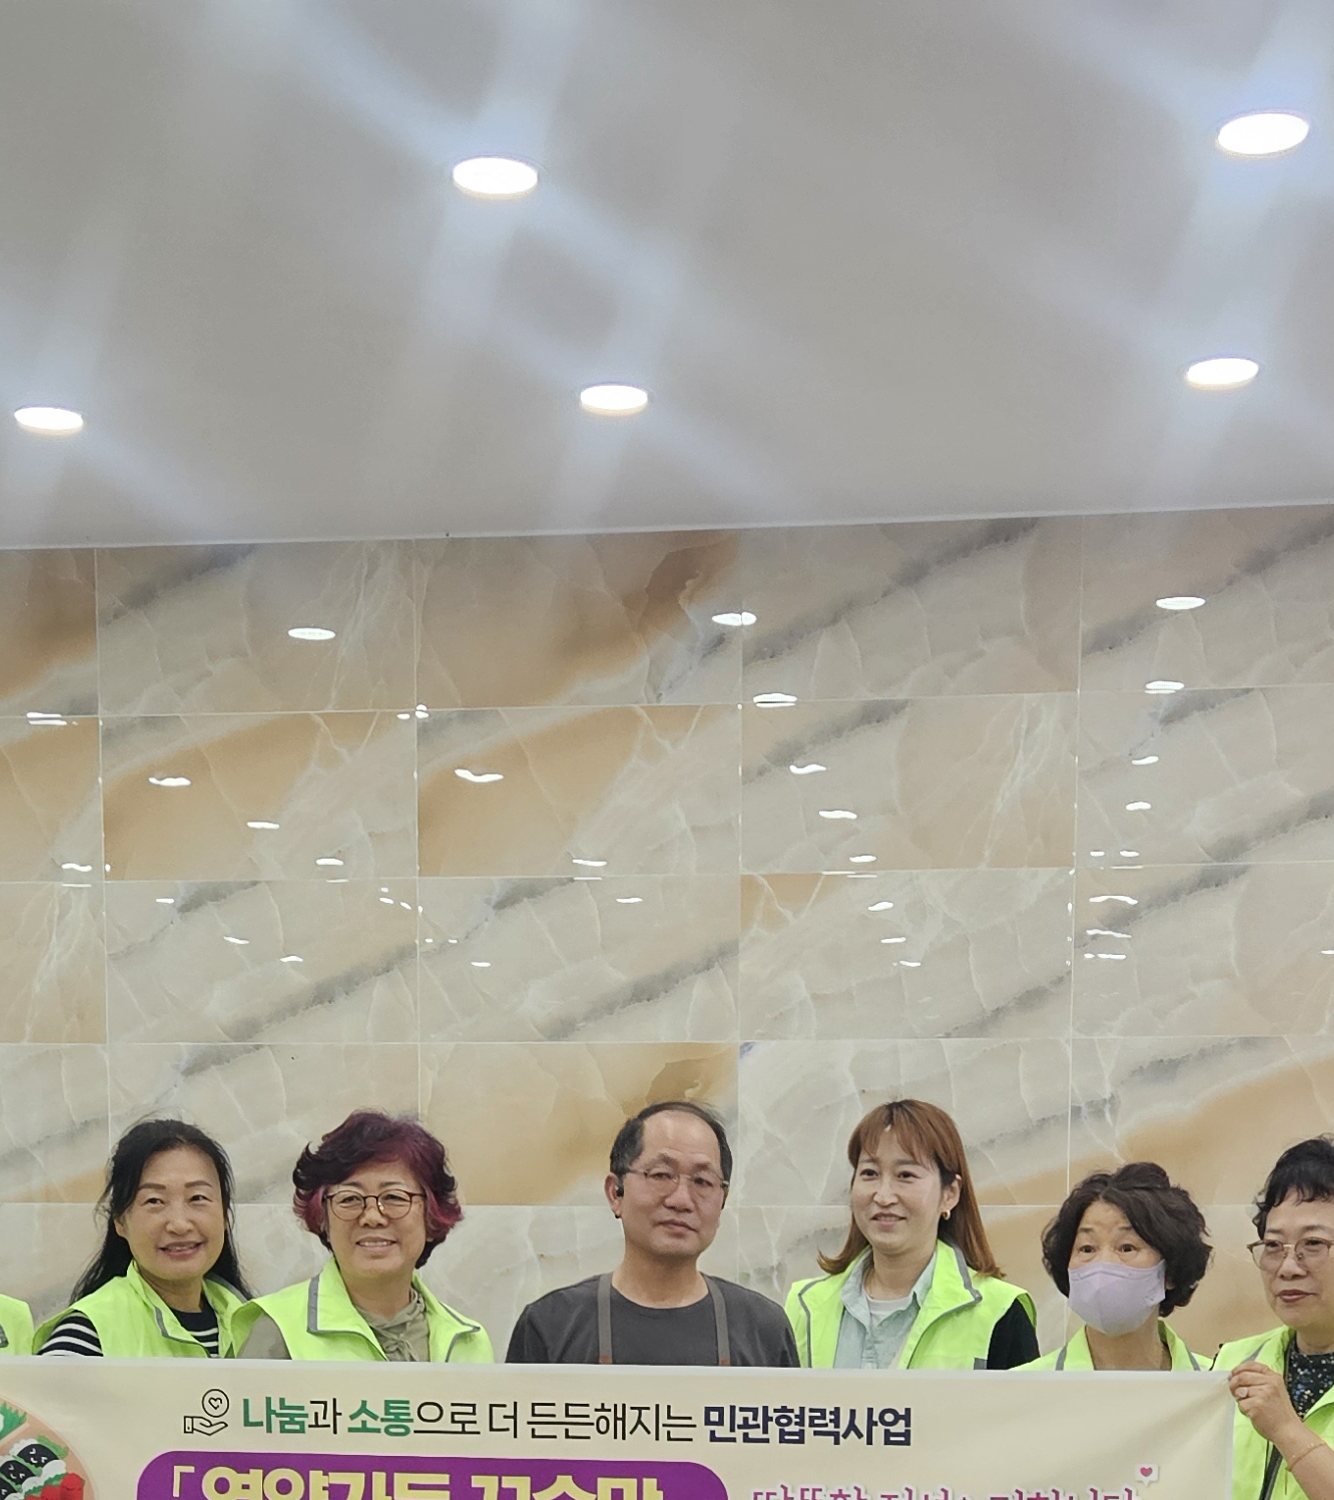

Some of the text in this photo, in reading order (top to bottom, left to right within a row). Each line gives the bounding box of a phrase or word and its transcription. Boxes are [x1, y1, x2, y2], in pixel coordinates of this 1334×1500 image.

[242, 1395, 912, 1447] 나눔과 소통으로 더 든든해지는 민관협력사업
